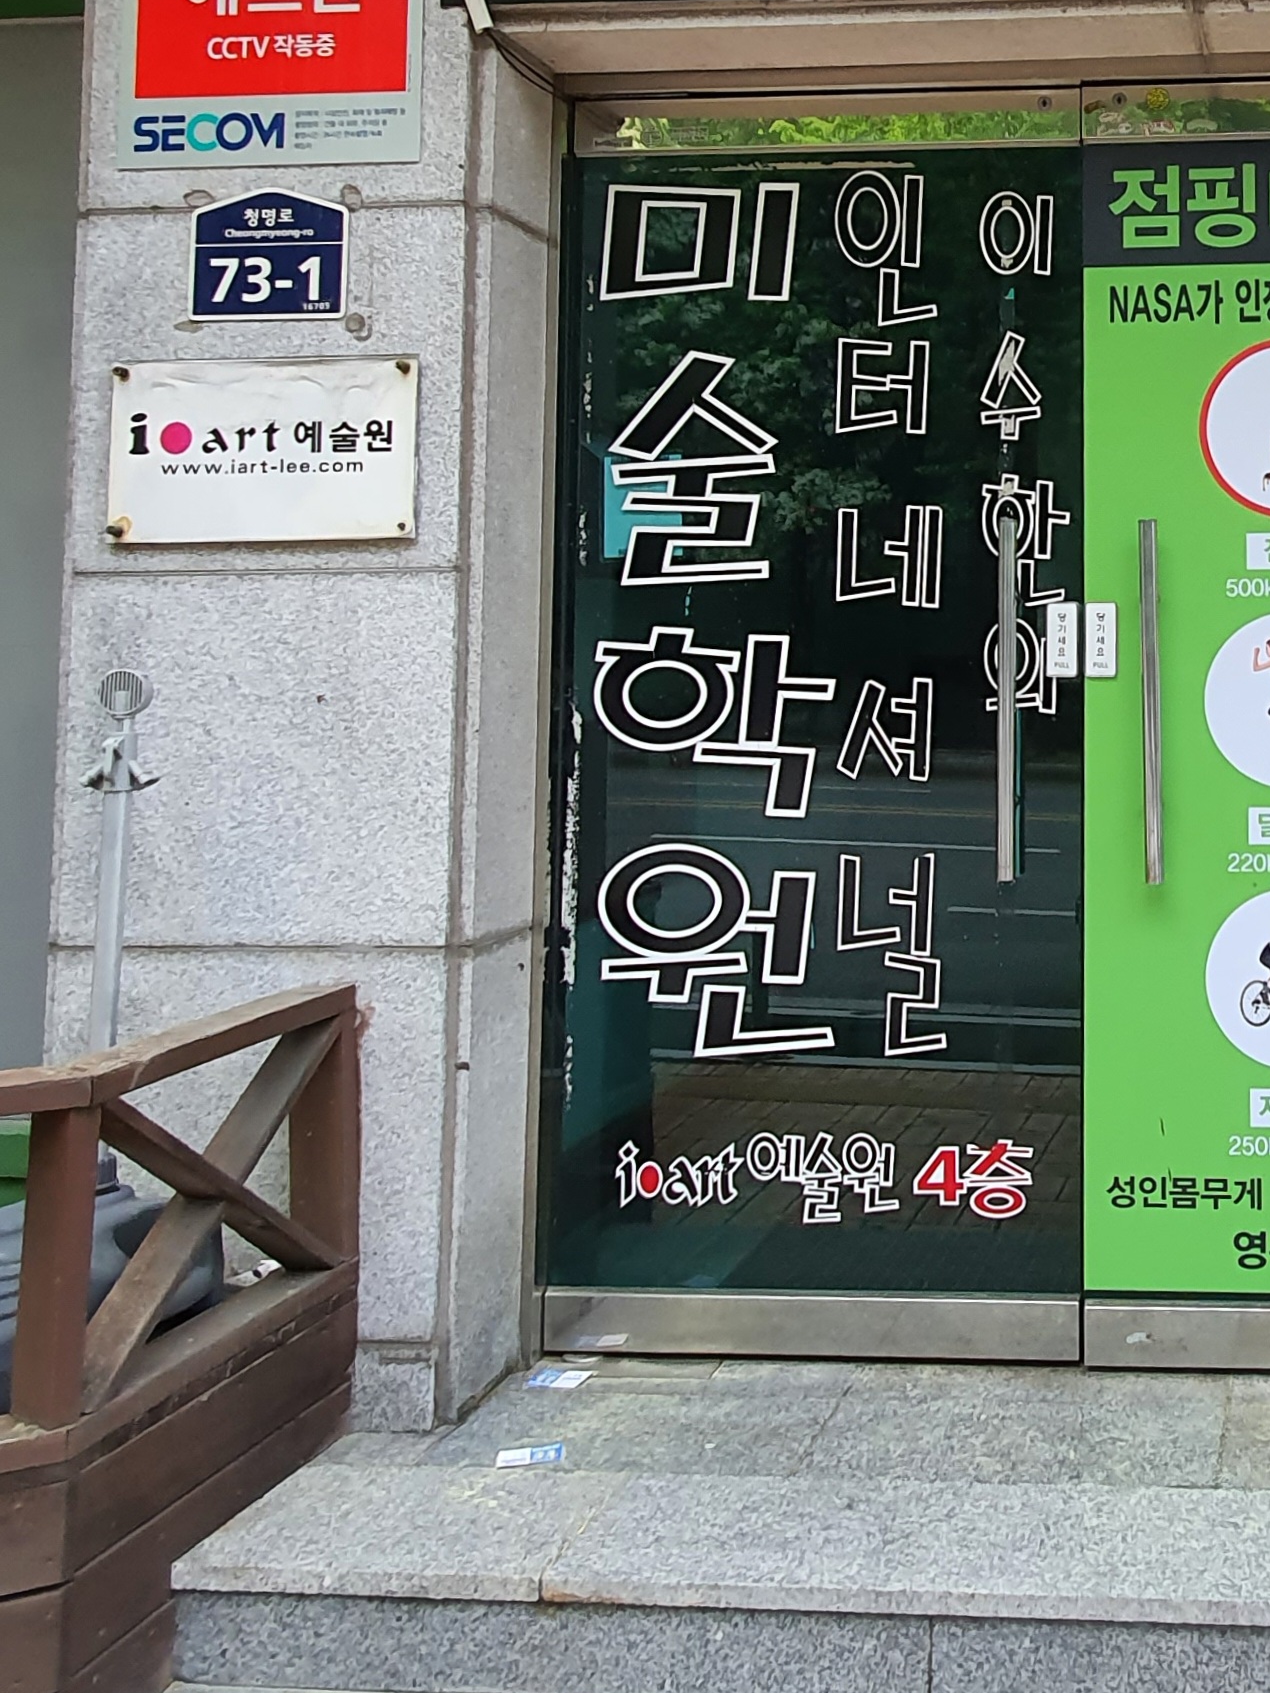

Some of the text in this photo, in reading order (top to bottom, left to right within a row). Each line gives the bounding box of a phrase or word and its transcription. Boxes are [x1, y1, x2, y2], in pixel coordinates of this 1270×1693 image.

[207, 34, 336, 59] CCTV 작동중
[134, 113, 285, 152] SECOM
[243, 208, 294, 227] 청명로
[209, 256, 321, 303] 73-1
[1109, 280, 1223, 324] NASA가
[294, 420, 393, 453] 예술원
[160, 458, 364, 475] www.iart-lee.com
[594, 182, 836, 1057] 미술학원
[834, 170, 947, 1056] 인터네셔널
[1057, 613, 1067, 657] 당기세요
[1096, 613, 1106, 657] 당기세요
[1054, 661, 1069, 669] PULL
[1092, 661, 1108, 669] PULL
[746, 1131, 900, 1224] 예술원
[913, 1138, 1034, 1219] 4층
[1106, 1176, 1262, 1210] 성인몸무게
